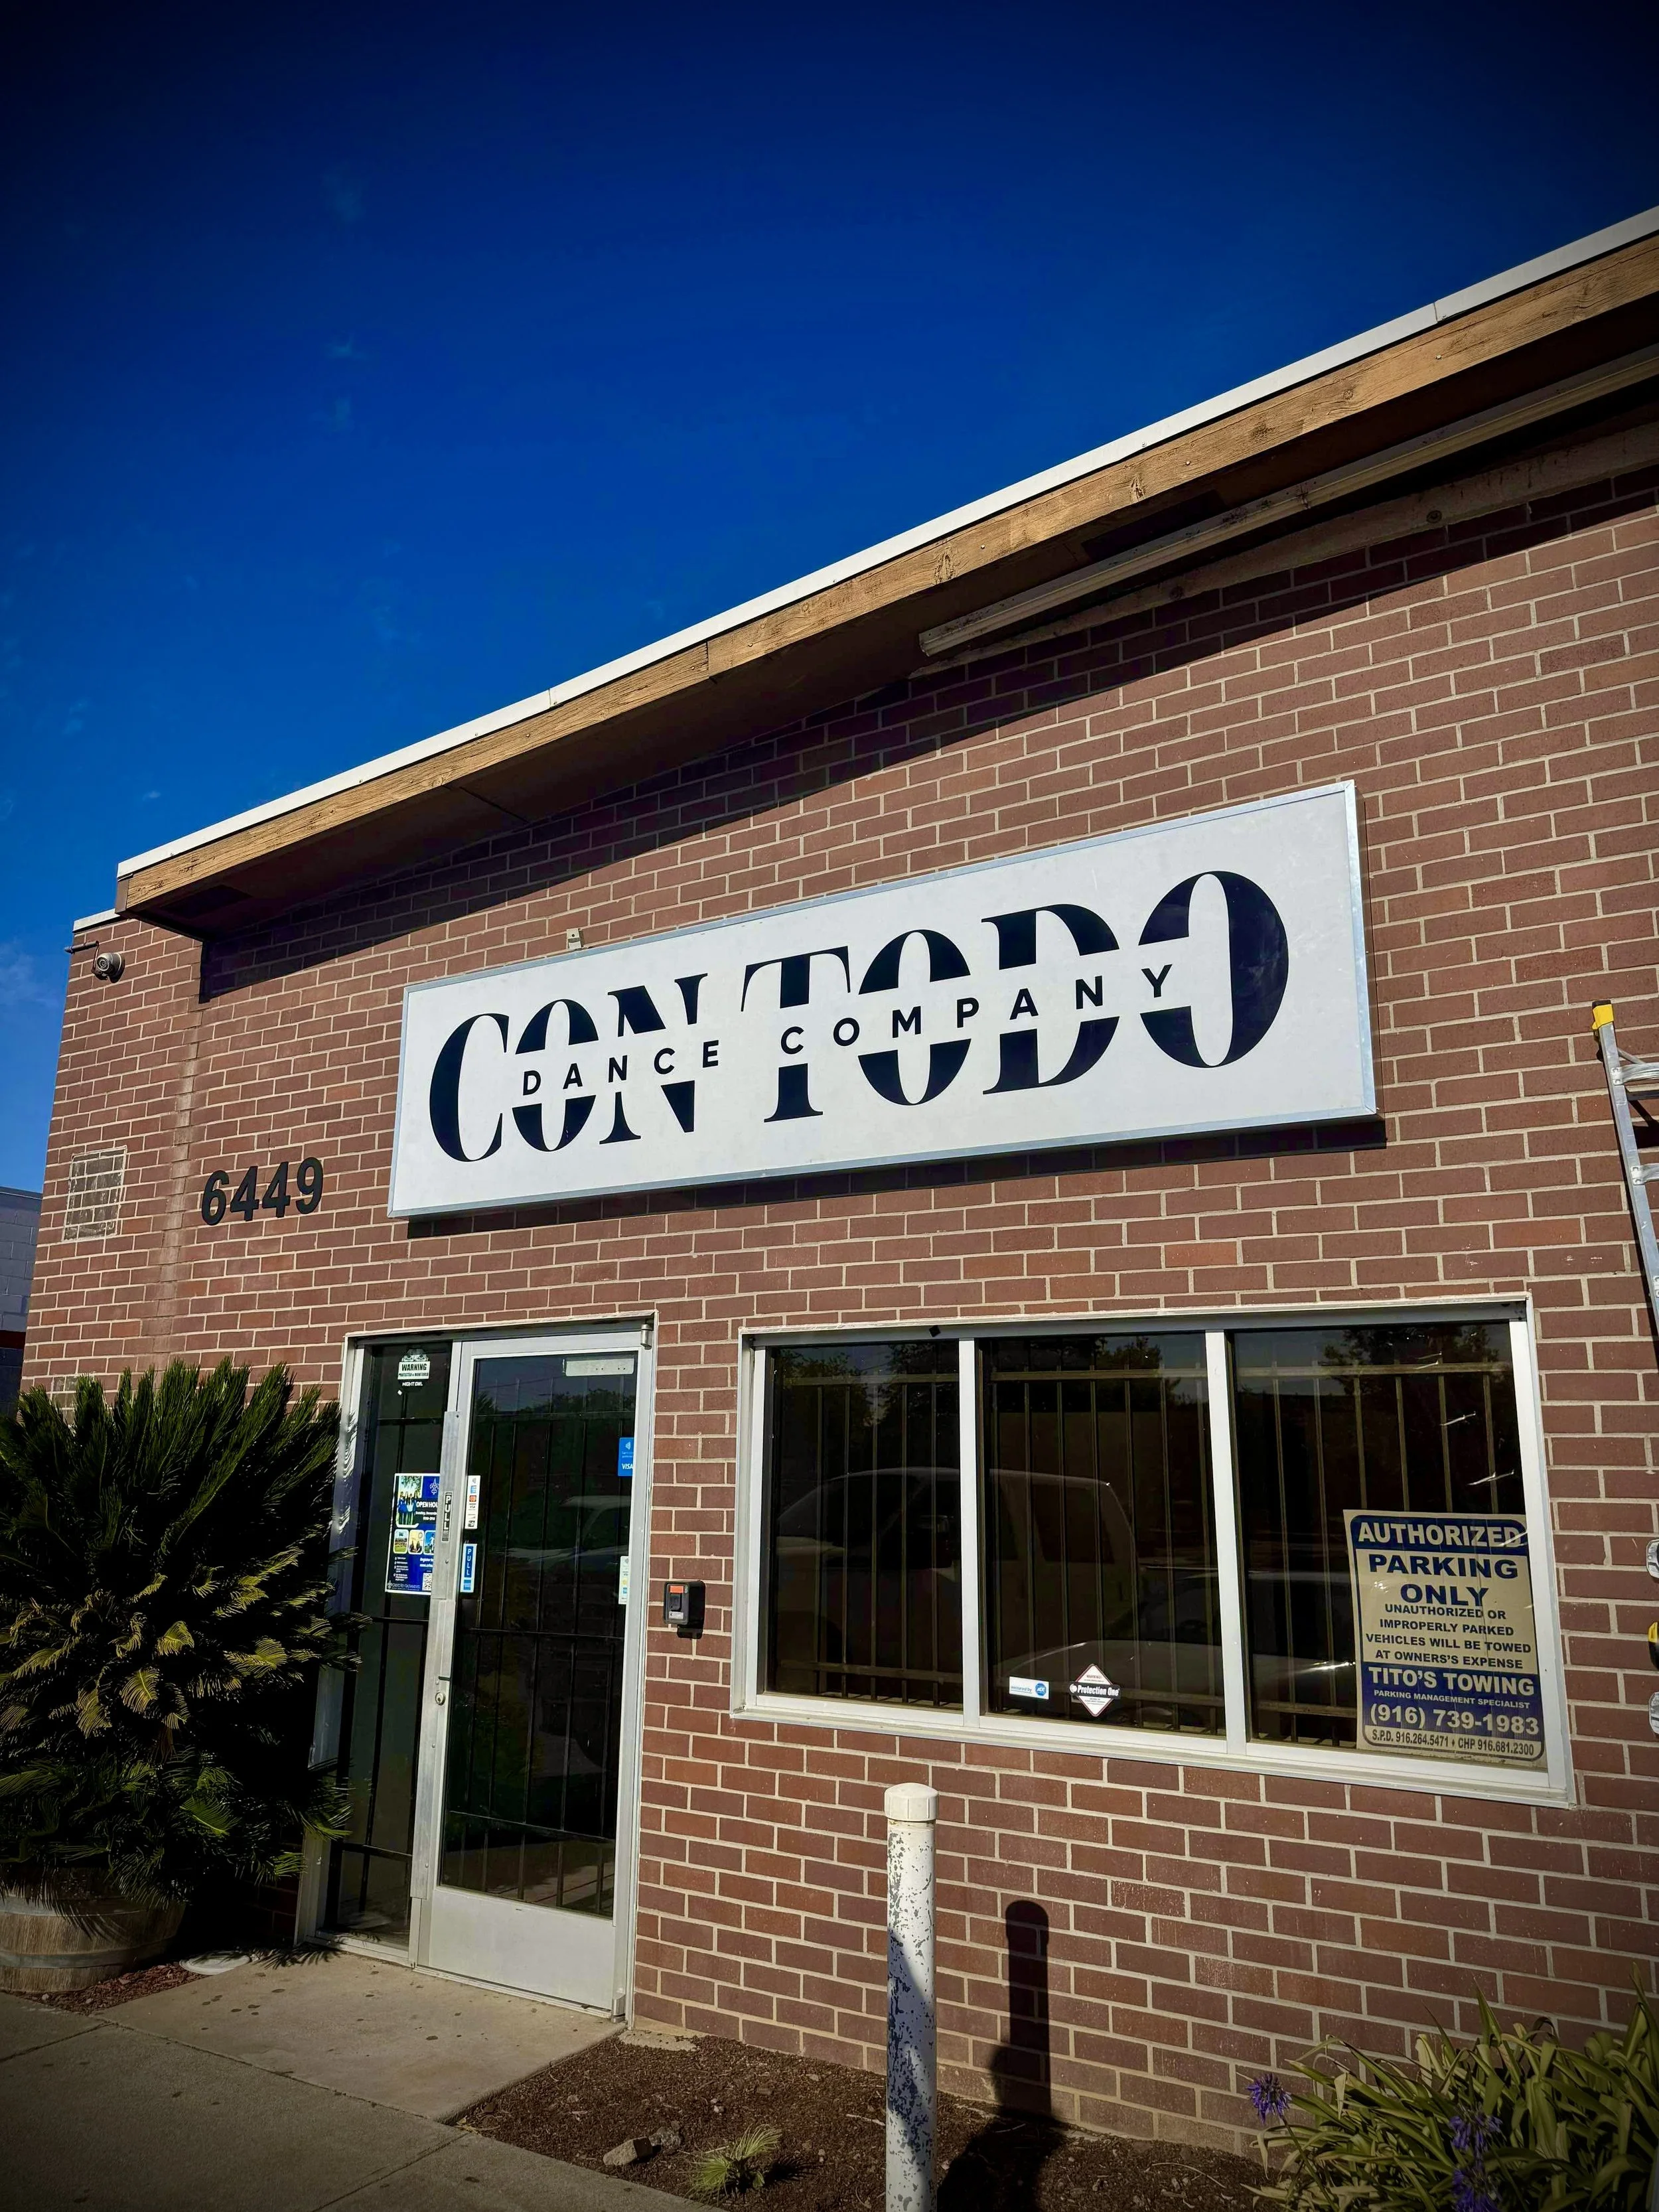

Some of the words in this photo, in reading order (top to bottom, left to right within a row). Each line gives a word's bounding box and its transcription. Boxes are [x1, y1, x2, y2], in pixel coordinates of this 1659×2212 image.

[429, 972, 707, 1162] CON
[741, 870, 1290, 1122] TODO
[522, 1039, 721, 1096] DANCE
[780, 963, 1173, 1055] COMPANY
[201, 1157, 324, 1226] 6449
[1358, 1522, 1522, 1548] AUTHORIZED
[1368, 1554, 1518, 1579] PARKING
[1400, 1584, 1489, 1606] ONLY
[1385, 1603, 1483, 1618] UNAUTHORIZED
[1488, 1609, 1506, 1619] OR
[1380, 1619, 1458, 1633] IMPROPERLY
[1463, 1624, 1514, 1636] PARKED
[1366, 1633, 1426, 1646] VEHICLES
[1429, 1638, 1460, 1649] WILL
[1465, 1640, 1480, 1650] BE
[1484, 1642, 1531, 1653] TOWED
[1375, 1650, 1390, 1659] AT
[1463, 1657, 1523, 1668] EXPENSE
[1077, 1684, 1107, 1696] Protection
[1108, 1687, 1119, 1696] One
[1368, 1666, 1437, 1688] TITO'S
[1443, 1672, 1534, 1696] TOWING
[1374, 1690, 1411, 1699] PARKING
[1413, 1693, 1475, 1704] MANAGEMENT
[1478, 1698, 1530, 1709] SPECIALIST
[1370, 1703, 1425, 1729] (916)
[1433, 1709, 1539, 1735] 739-1983
[1372, 1729, 1394, 1741] S.P.D.
[1396, 1731, 1449, 1747] 916.264.5471
[1458, 1739, 1476, 1749] CHP
[1477, 1739, 1534, 1756] 916.681.2300
